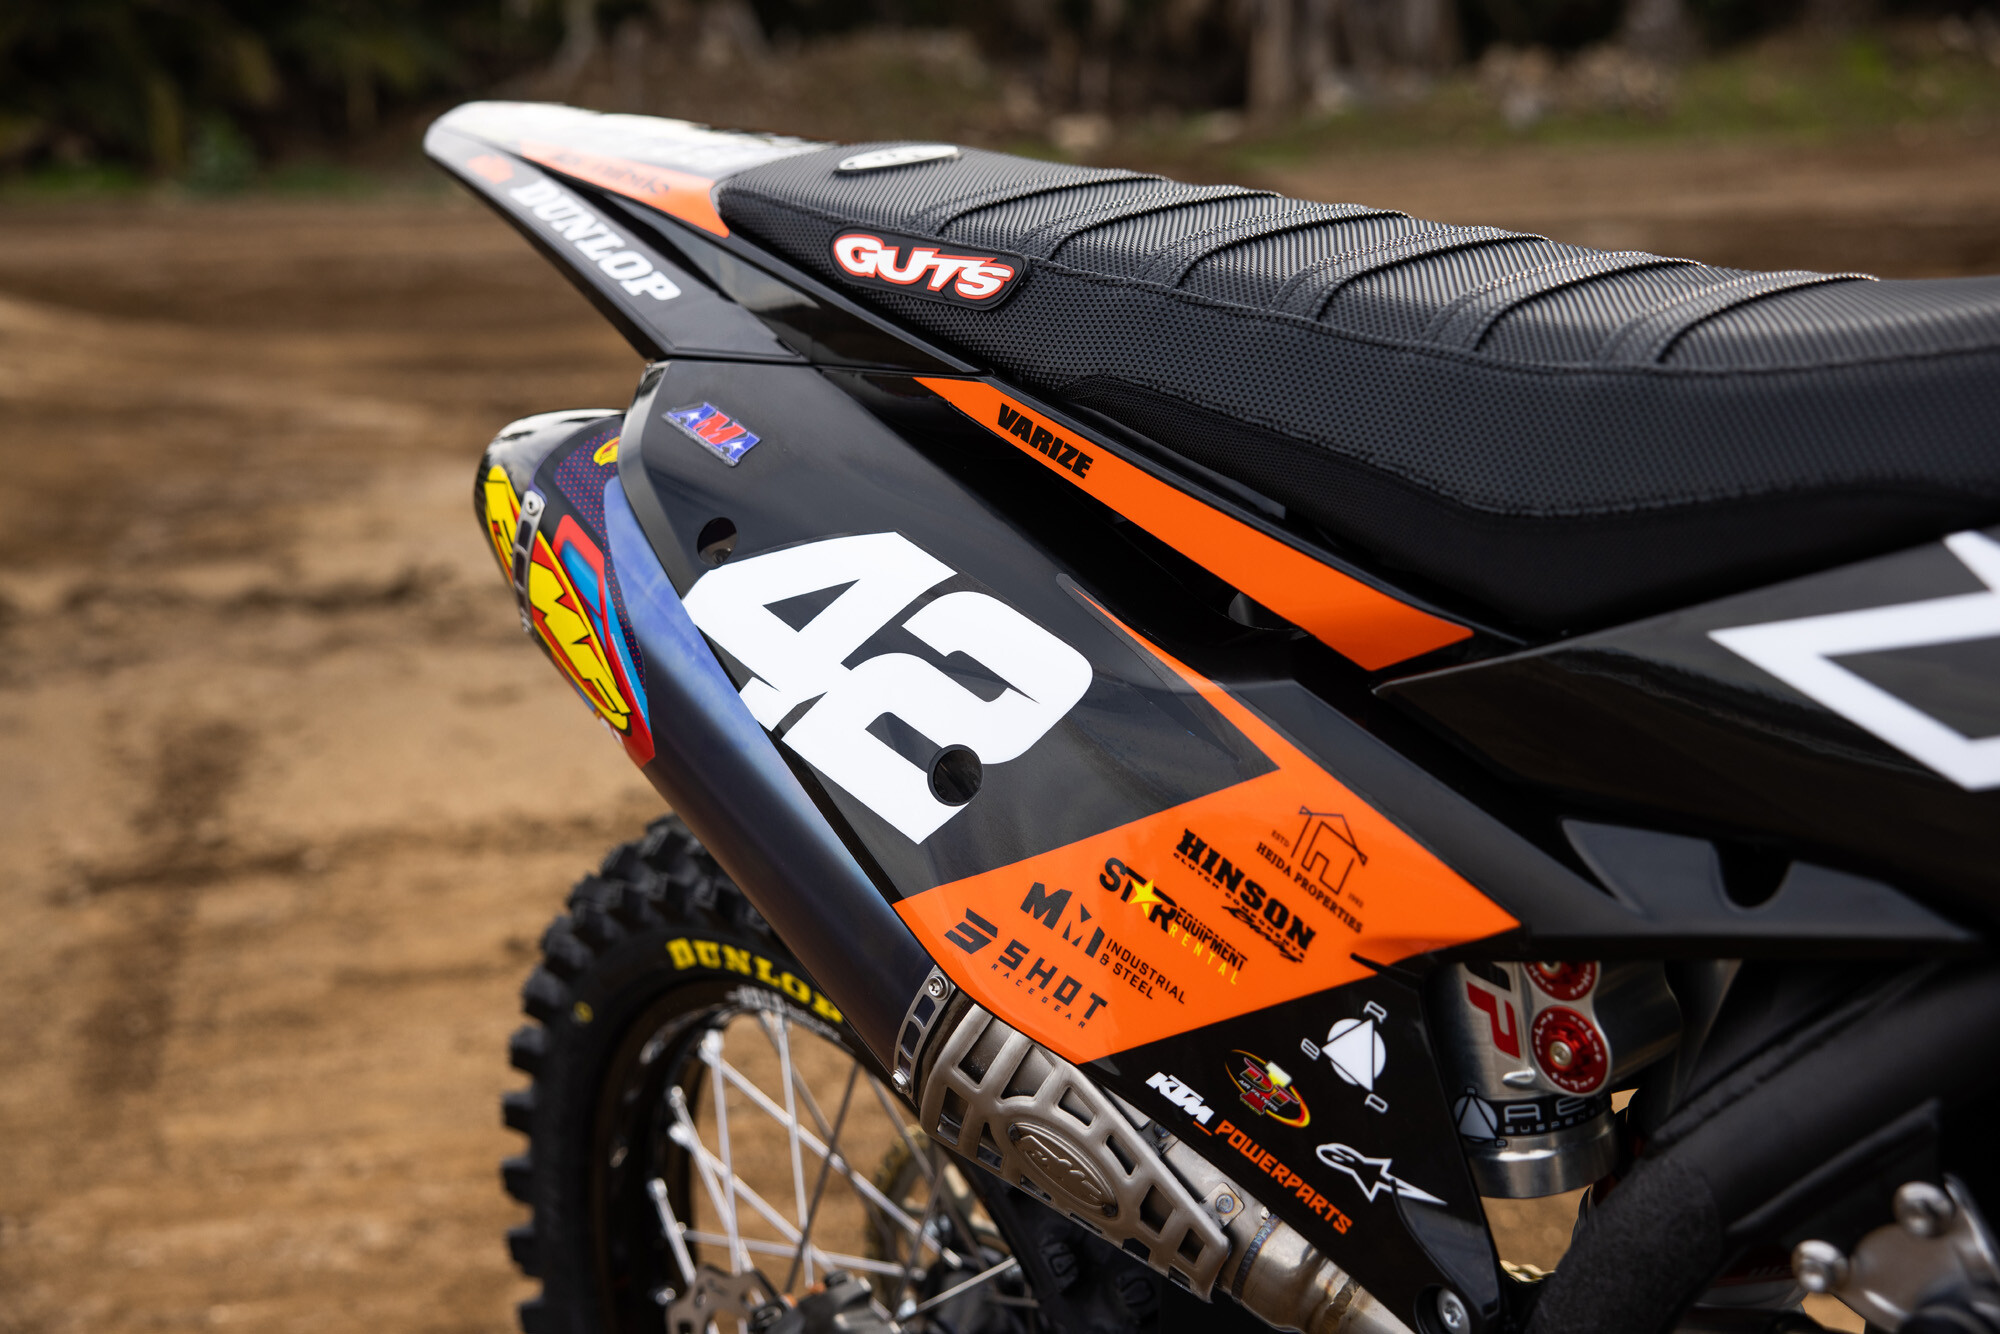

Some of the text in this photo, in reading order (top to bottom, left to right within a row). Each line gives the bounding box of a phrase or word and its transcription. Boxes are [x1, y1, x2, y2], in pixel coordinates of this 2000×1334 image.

[509, 179, 682, 301] DUNLOP
[833, 234, 1015, 299] GUTS
[667, 402, 760, 463] AMA
[997, 402, 1094, 480] VARIZE
[682, 531, 1094, 846] 42
[1173, 852, 1219, 889] CLUTCH
[1176, 828, 1316, 951] HINSON
[1293, 871, 1363, 934] PROPERTIES
[1106, 938, 1186, 1004] INDUSTRIAL
[1168, 923, 1238, 985] RENTAL
[1174, 906, 1248, 971] EQUIPMENT
[665, 937, 843, 1023] DUNLOP
[998, 939, 1107, 1021] SHOT
[1112, 961, 1154, 1000] STEEL
[1145, 1071, 1215, 1126] KTM
